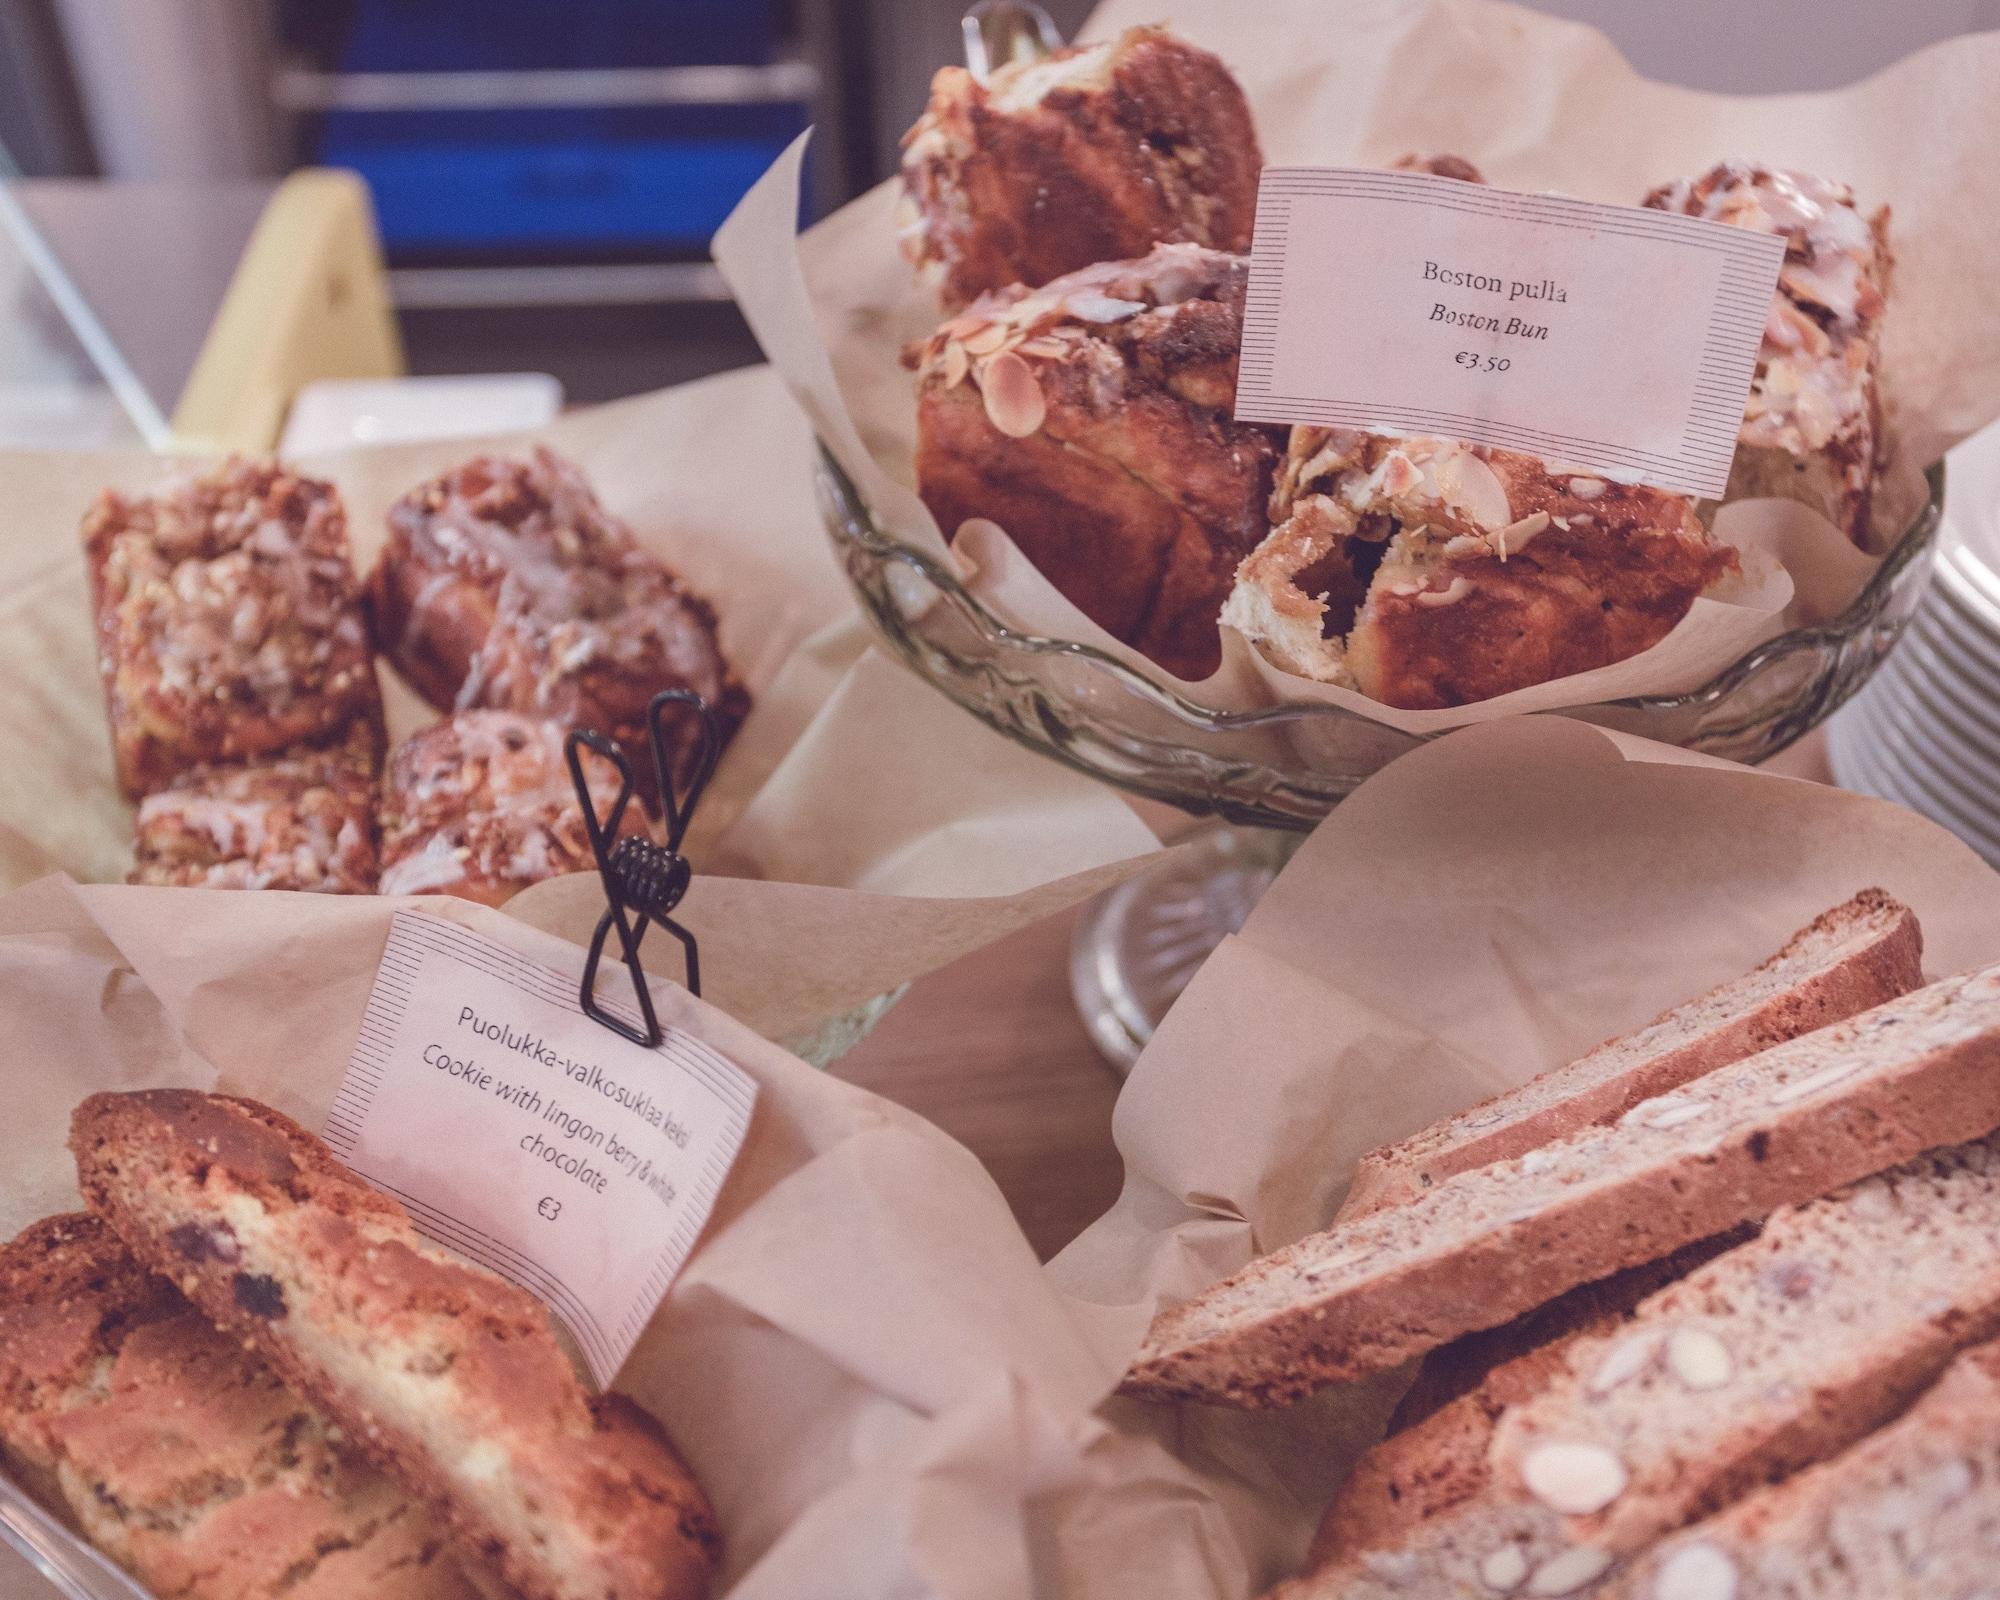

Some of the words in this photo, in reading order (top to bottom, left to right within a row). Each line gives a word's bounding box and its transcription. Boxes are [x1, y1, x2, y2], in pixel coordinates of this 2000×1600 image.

[1422, 261, 1502, 293] Boston
[1508, 280, 1568, 303] pulla
[1428, 303, 1500, 332] Boston
[1504, 317, 1549, 340] Bun
[1455, 351, 1511, 373] €3.50
[457, 1006, 664, 1128] Puolukka-valkosuklaa
[422, 1044, 493, 1091] Cookie
[496, 1078, 542, 1114] with
[542, 1099, 605, 1148] lingon
[605, 1133, 640, 1177] berry
[638, 1160, 652, 1182] &
[520, 1133, 608, 1194] chocolate
[537, 1196, 563, 1222] €3
